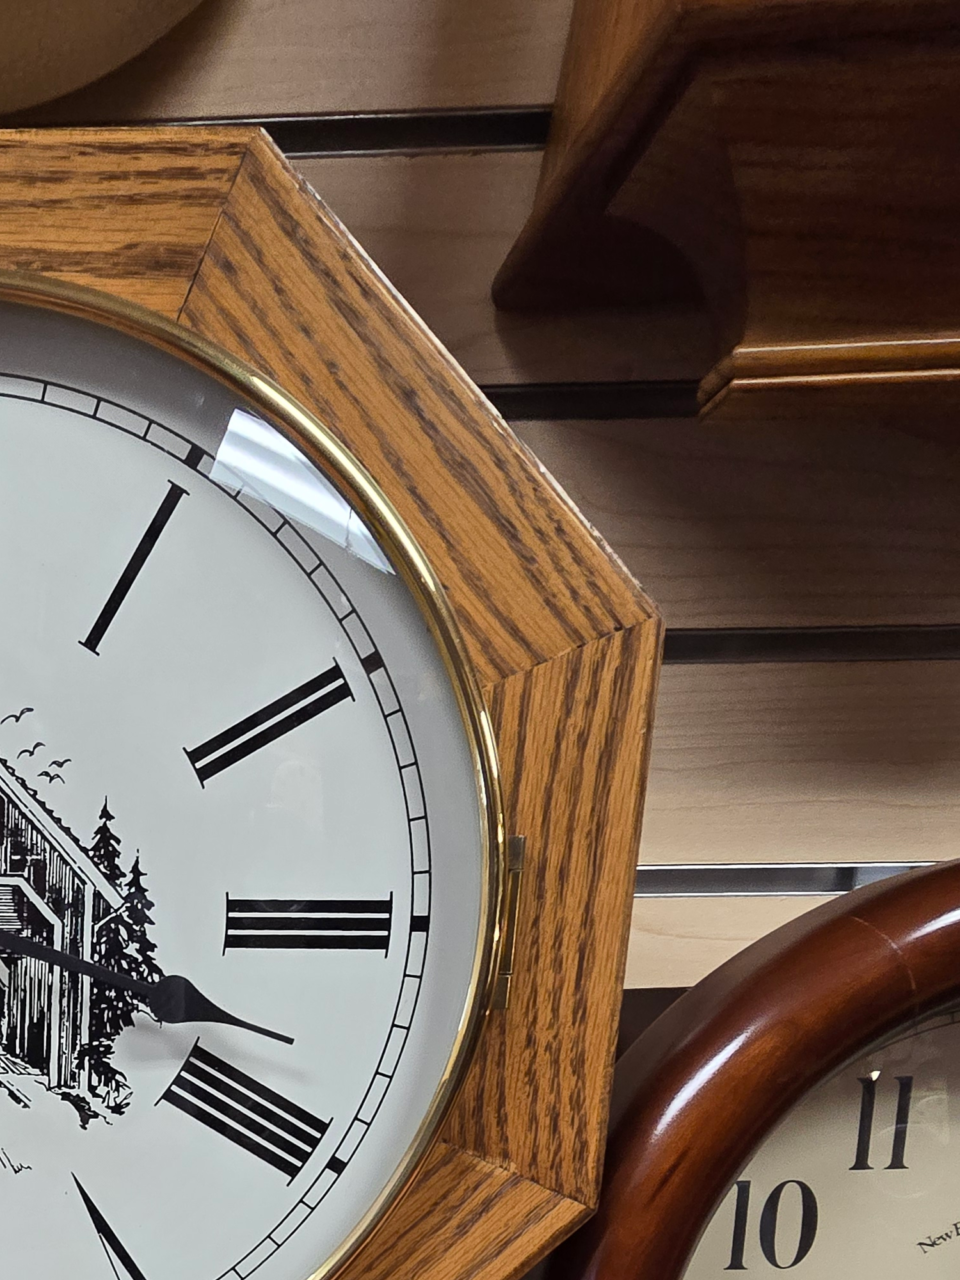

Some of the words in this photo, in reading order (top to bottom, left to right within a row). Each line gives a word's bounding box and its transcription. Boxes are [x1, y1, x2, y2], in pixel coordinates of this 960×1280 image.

[78, 479, 189, 656] I
[183, 659, 356, 788] II
[223, 892, 393, 958] III
[157, 1039, 332, 1186] IIII
[848, 1075, 917, 1171] 11
[722, 1179, 819, 1272] 10
[916, 1231, 954, 1254] New
